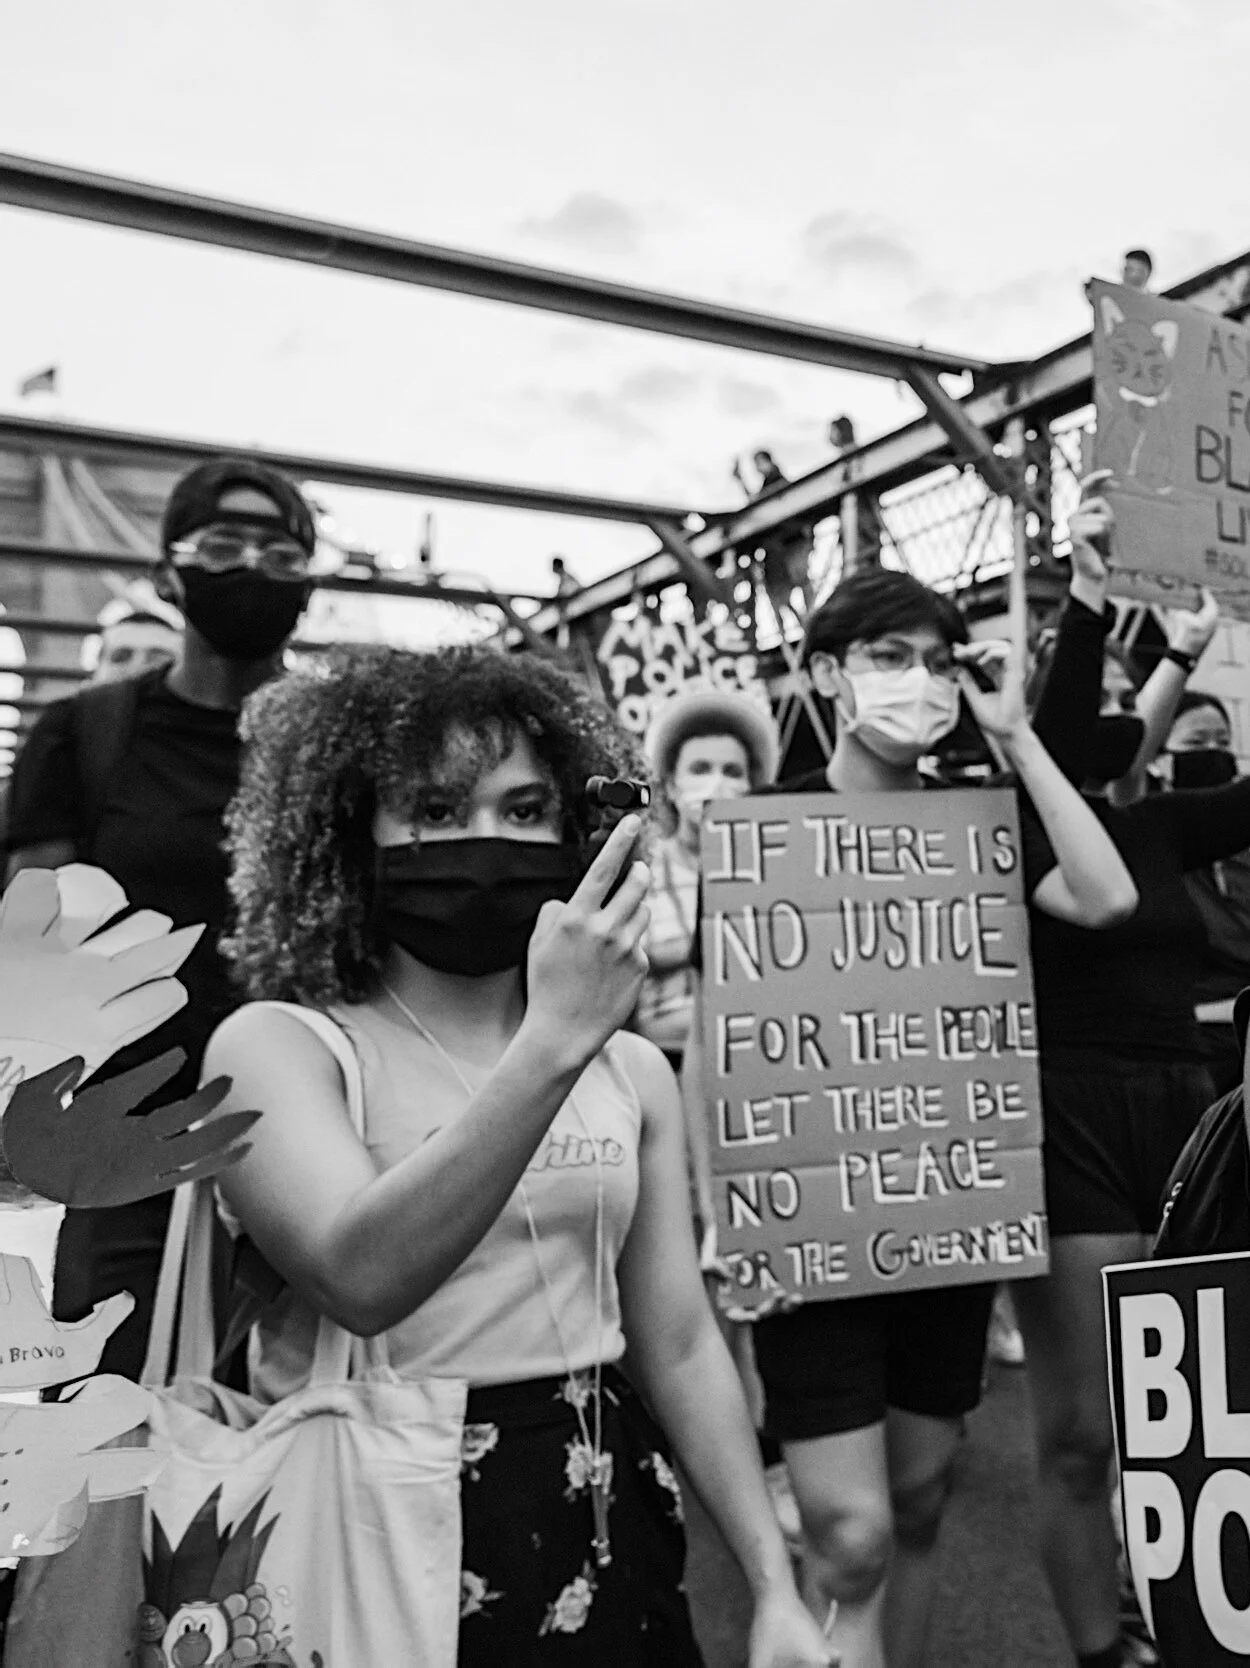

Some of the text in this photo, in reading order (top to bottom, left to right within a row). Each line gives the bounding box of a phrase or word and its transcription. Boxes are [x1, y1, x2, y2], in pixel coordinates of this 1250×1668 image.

[706, 815, 1018, 885] IF THERE IS
[713, 893, 1019, 985] NO JUSTICE
[716, 1001, 1039, 1077] FOR THE PEOPLE
[718, 1080, 1028, 1147] LET THERE BE
[727, 1138, 1007, 1229] NO PEACE
[785, 1239, 851, 1288] THE
